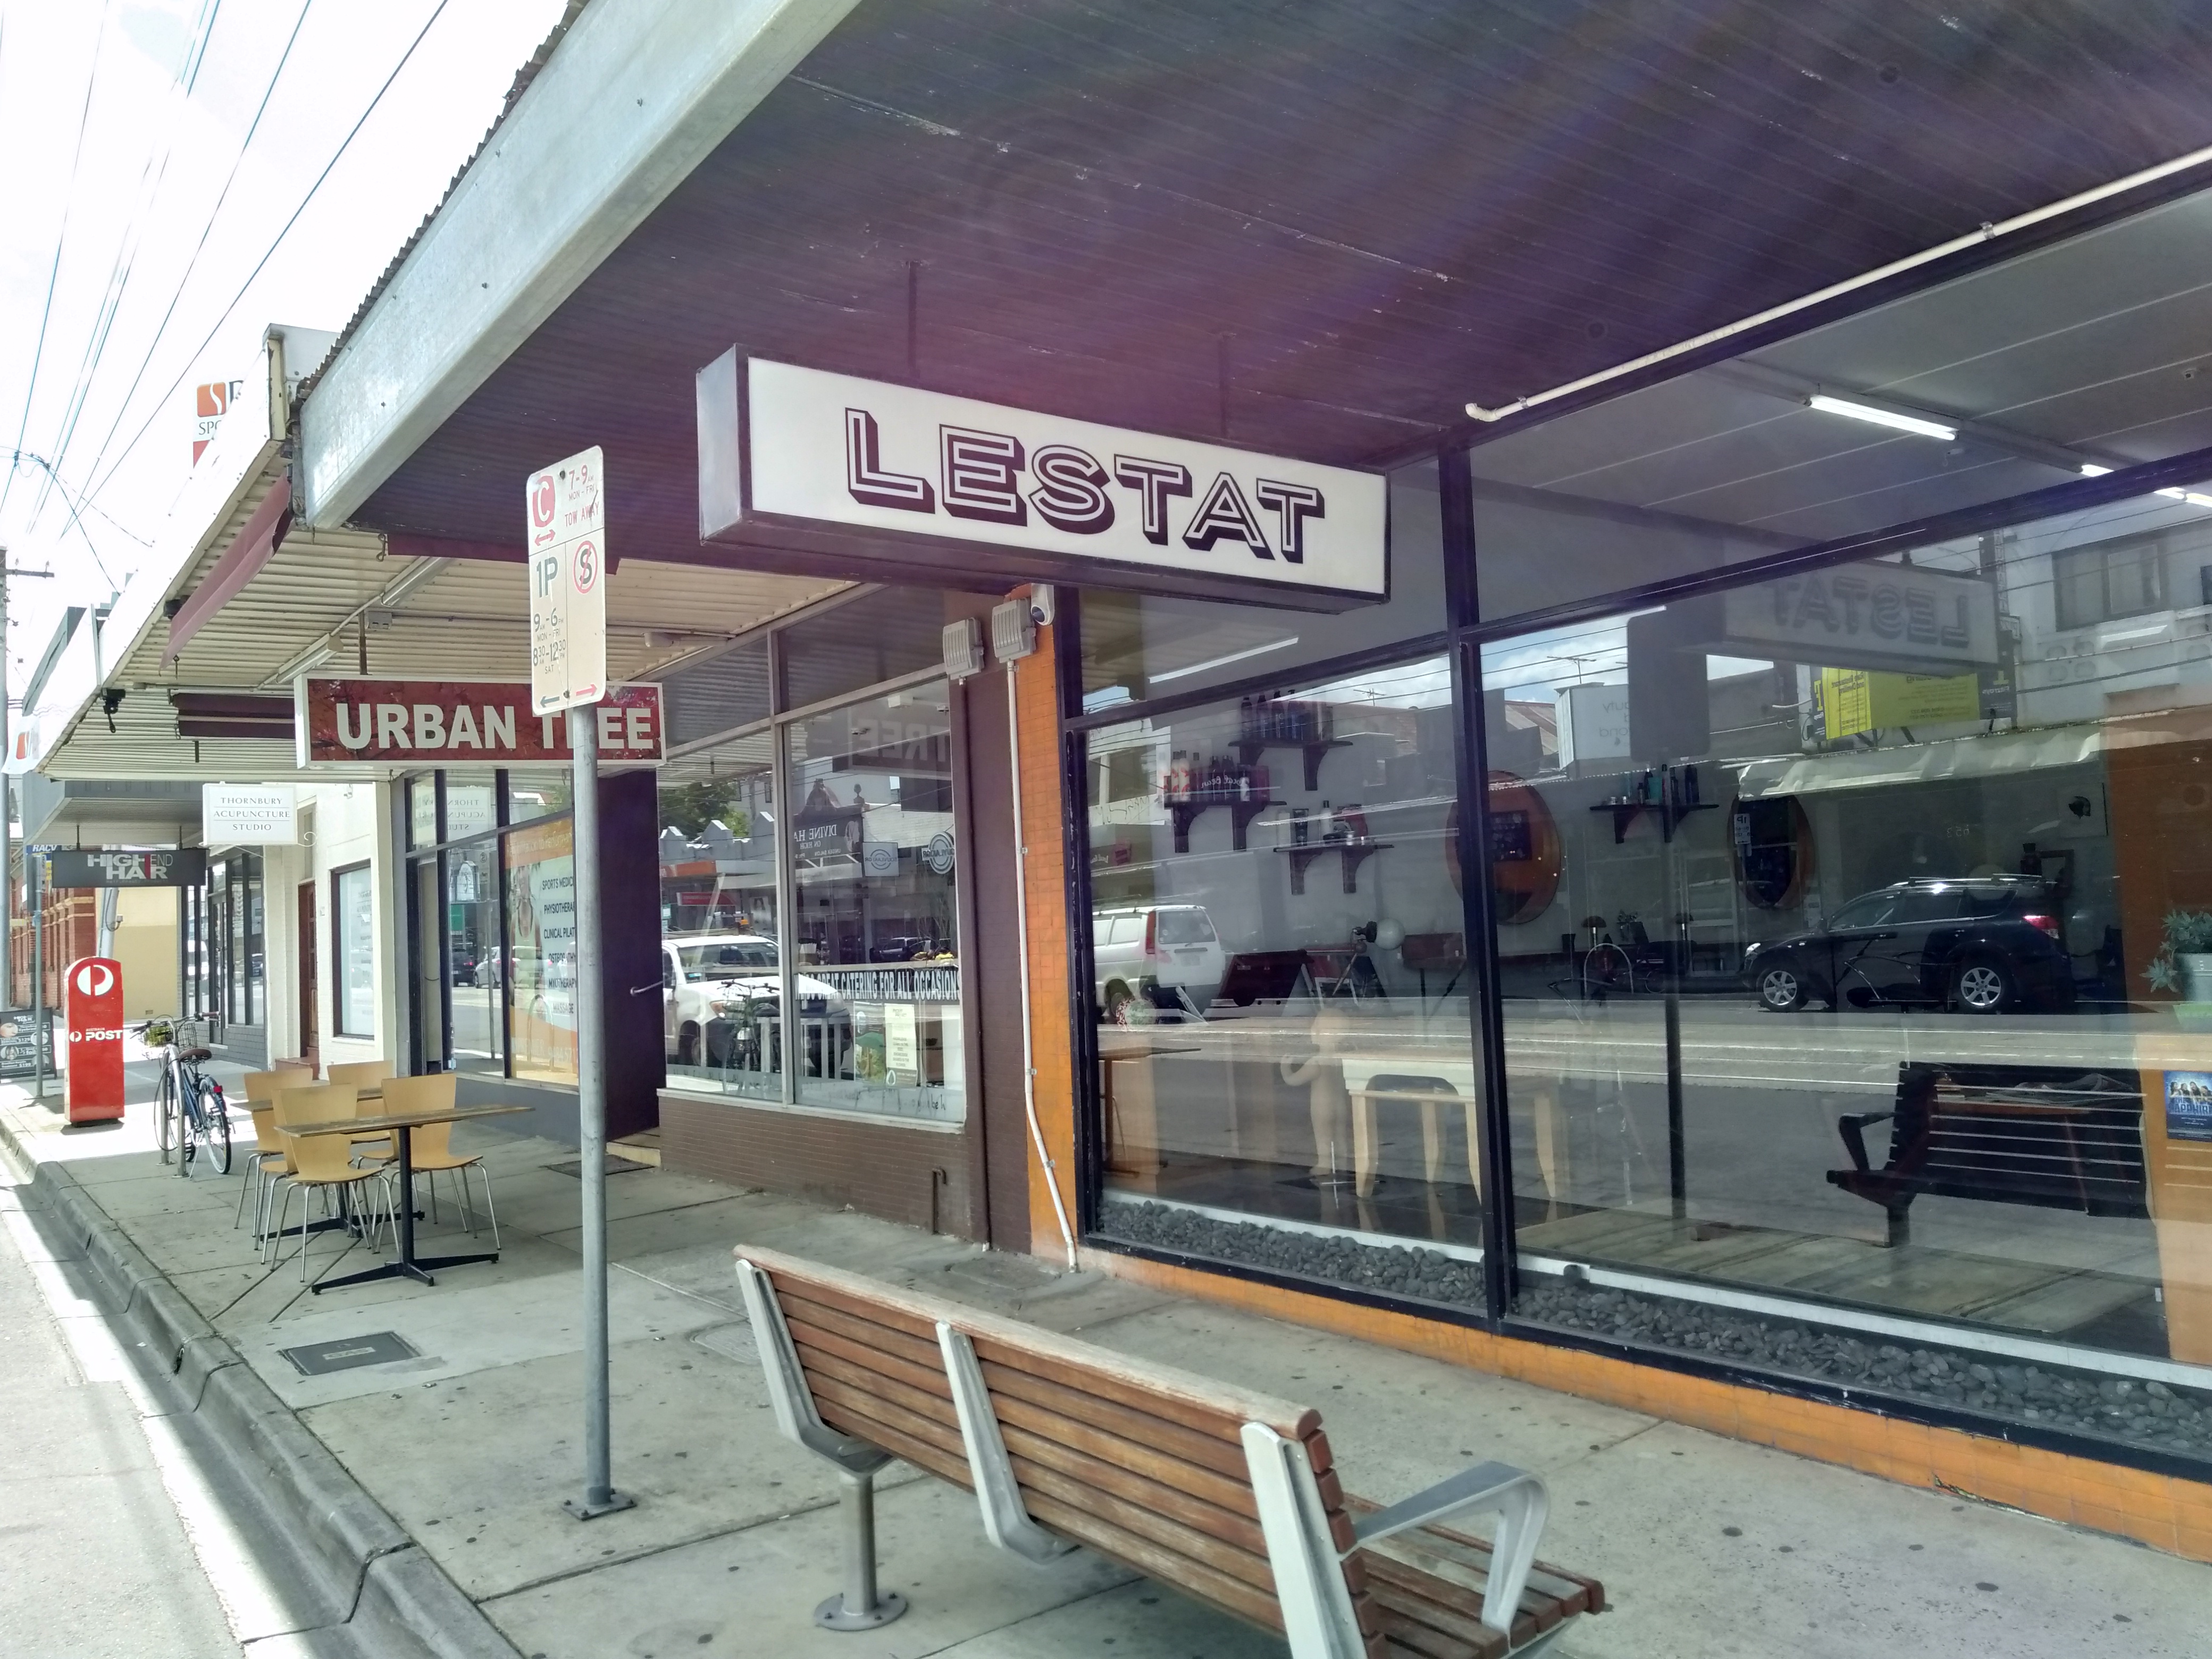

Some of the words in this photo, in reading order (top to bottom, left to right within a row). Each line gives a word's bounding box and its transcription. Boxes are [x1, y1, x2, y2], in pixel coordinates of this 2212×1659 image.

[844, 407, 1325, 564] LESTAT
[568, 490, 580, 501] MON
[586, 484, 594, 494] FRI
[565, 510, 577, 527] TOW
[581, 501, 599, 521] AWAY
[536, 556, 558, 598] 1P
[545, 664, 554, 674] SAT
[336, 703, 517, 750] URBAN
[532, 707, 653, 749] TEE
[87, 854, 150, 867] HIGH
[150, 854, 173, 867] END
[106, 866, 168, 879] HAIR
[542, 878, 559, 891] SPORTS
[544, 928, 562, 939] CLINICAL
[549, 952, 576, 963] OSTEOPATHY
[841, 971, 877, 1000] CATERING
[879, 971, 895, 1000] FOR
[897, 971, 912, 1000] ALL
[553, 1002, 574, 1014] MASSAGE
[86, 1030, 123, 1041] POST
